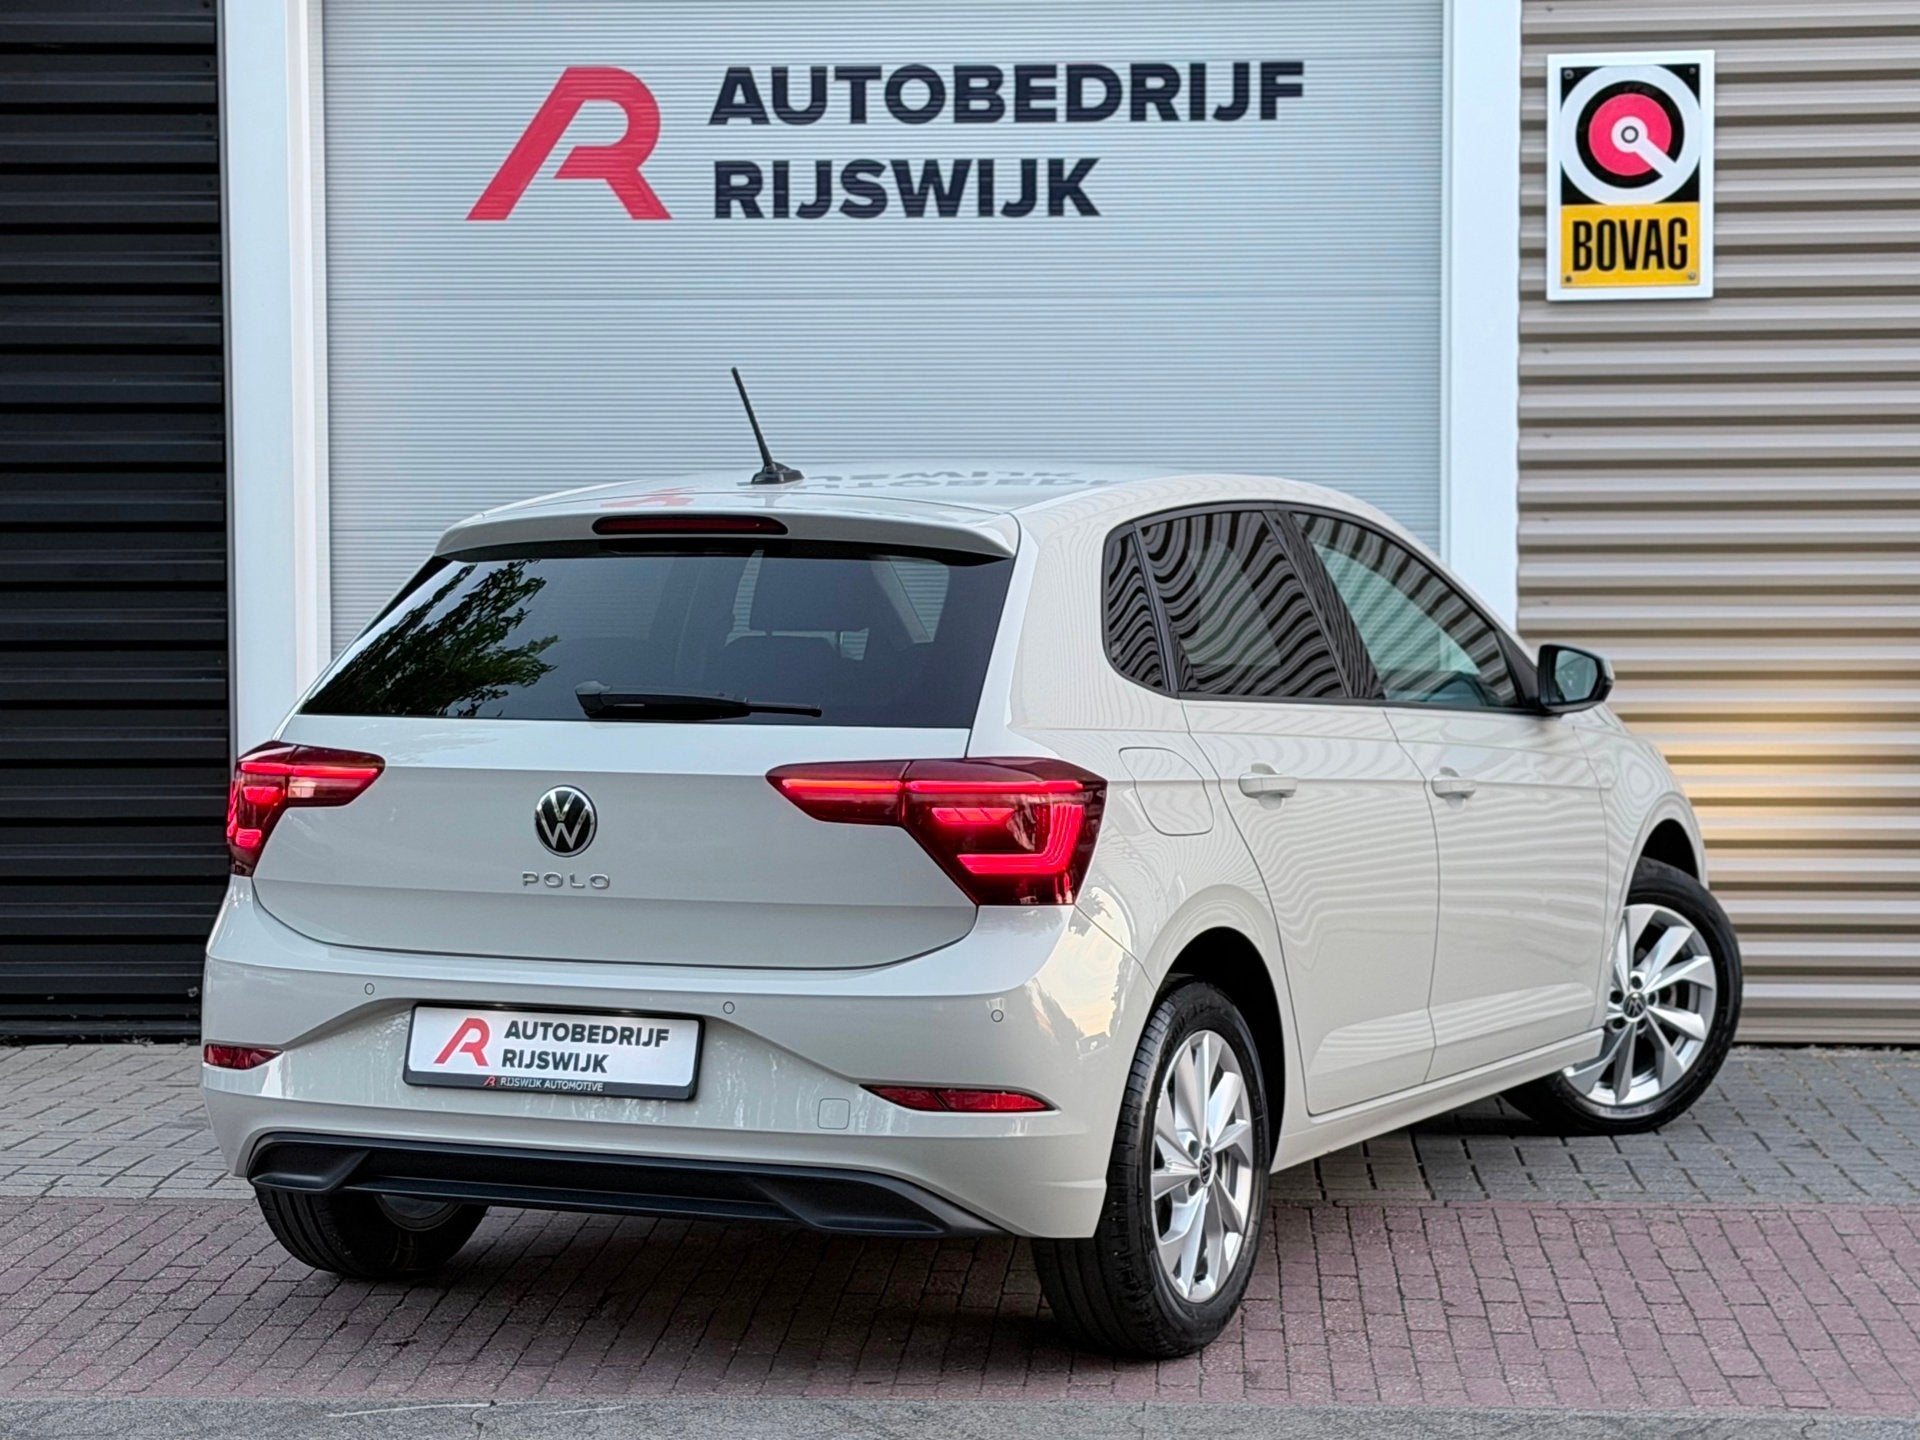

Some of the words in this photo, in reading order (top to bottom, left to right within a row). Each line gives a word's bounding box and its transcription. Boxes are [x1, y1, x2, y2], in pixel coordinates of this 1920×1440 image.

[709, 61, 1304, 125] AUTOBEDRIJF
[715, 158, 1102, 220] RIJSWIJK
[1573, 217, 1688, 271] BOVAG
[522, 871, 610, 890] POLO
[504, 1020, 670, 1047] AUTOBEDRIJF
[502, 1049, 609, 1073] RIJSWIJK
[500, 1077, 542, 1088] RIJSWIJK
[543, 1079, 604, 1092] AUTOMOTIVE
